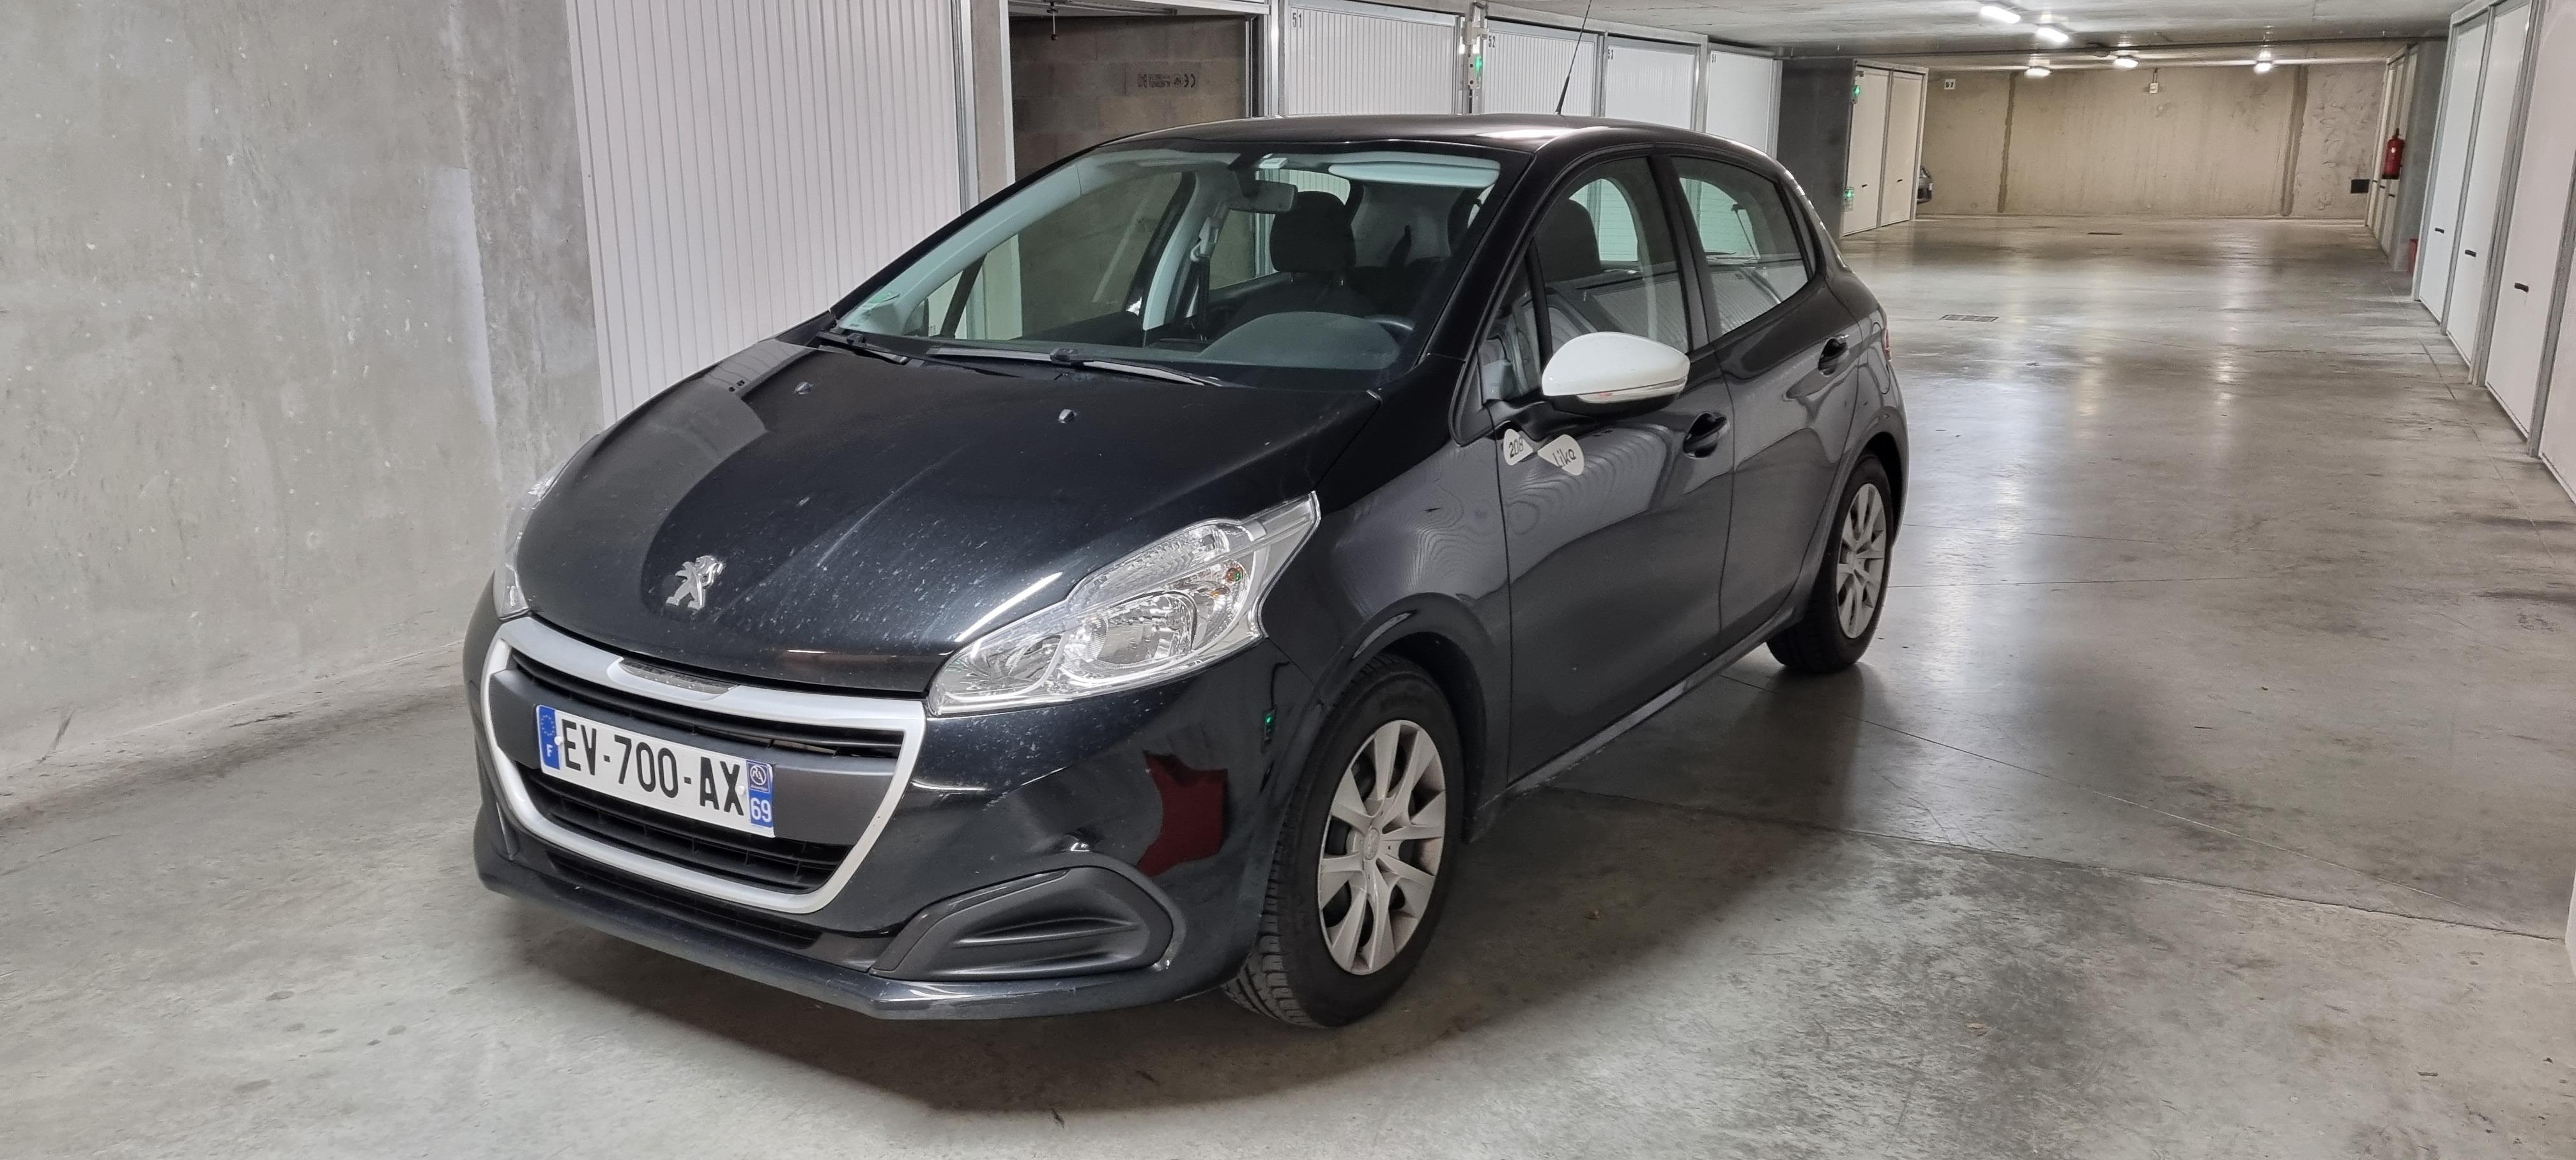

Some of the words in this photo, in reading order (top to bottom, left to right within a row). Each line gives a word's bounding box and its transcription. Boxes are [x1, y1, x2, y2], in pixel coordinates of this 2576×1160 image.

[1292, 12, 1302, 28] 51
[1489, 35, 1495, 47] 52
[1508, 438, 1524, 459] 208
[546, 744, 553, 758] F
[562, 719, 744, 816] EV-700-AX
[751, 797, 772, 823] 69
